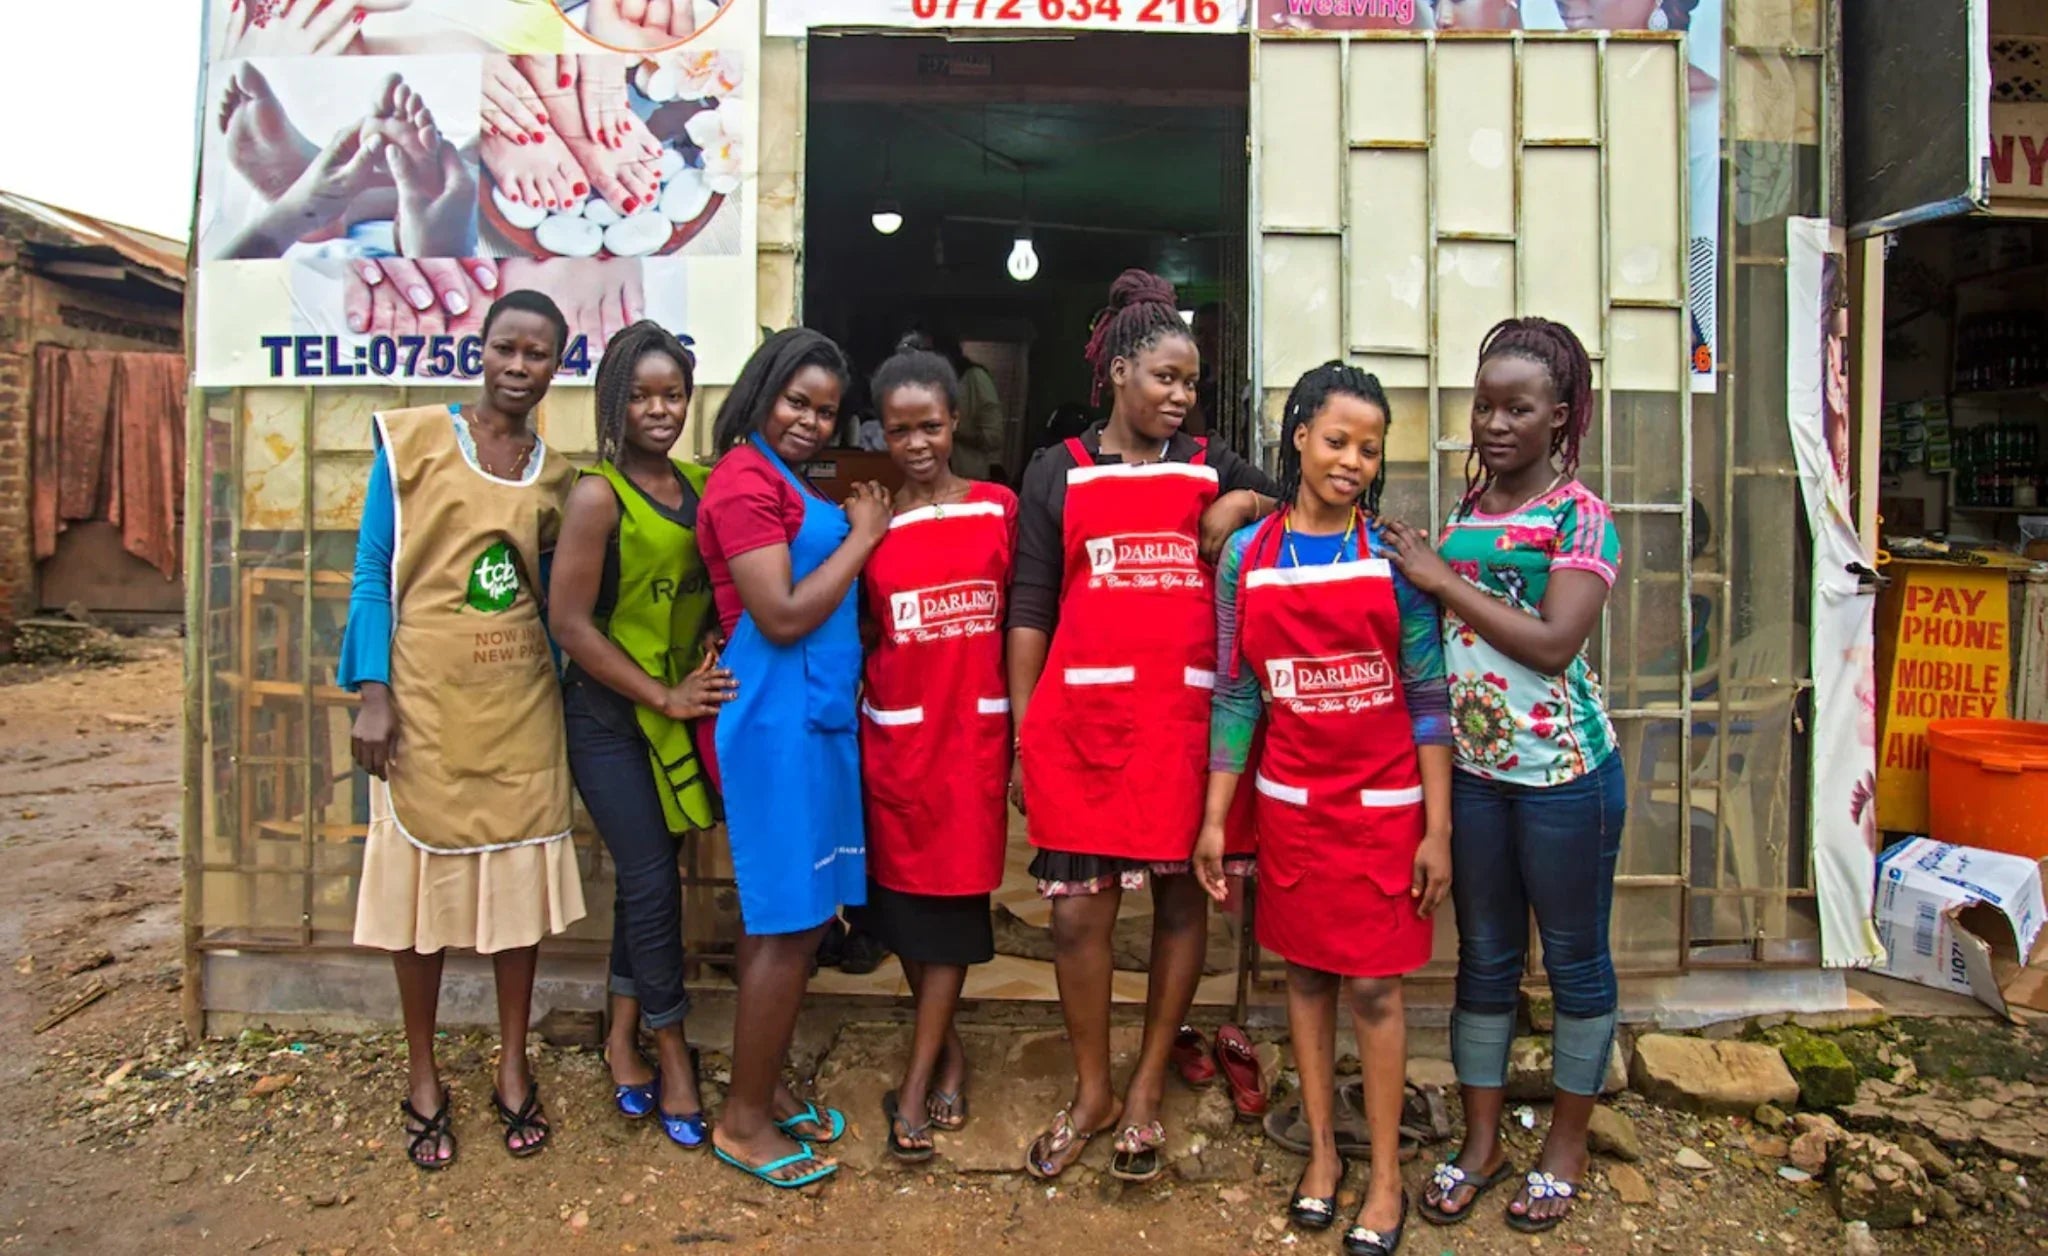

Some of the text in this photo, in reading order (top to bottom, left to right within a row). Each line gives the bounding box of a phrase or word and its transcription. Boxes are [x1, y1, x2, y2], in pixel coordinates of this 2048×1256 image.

[1039, 0, 1121, 21] 634
[1137, 0, 1219, 24] 216
[1119, 543, 1193, 562] DARLING
[475, 550, 516, 589] tcb
[923, 591, 994, 616] DARLING
[1906, 585, 1987, 616] PAY
[475, 630, 517, 646] NOW
[1902, 616, 2005, 650] PHONE
[473, 647, 514, 663] NEW
[1299, 661, 1383, 684] DARLING
[1897, 658, 1999, 694] MOBILE
[1896, 691, 1997, 719] MONEY
